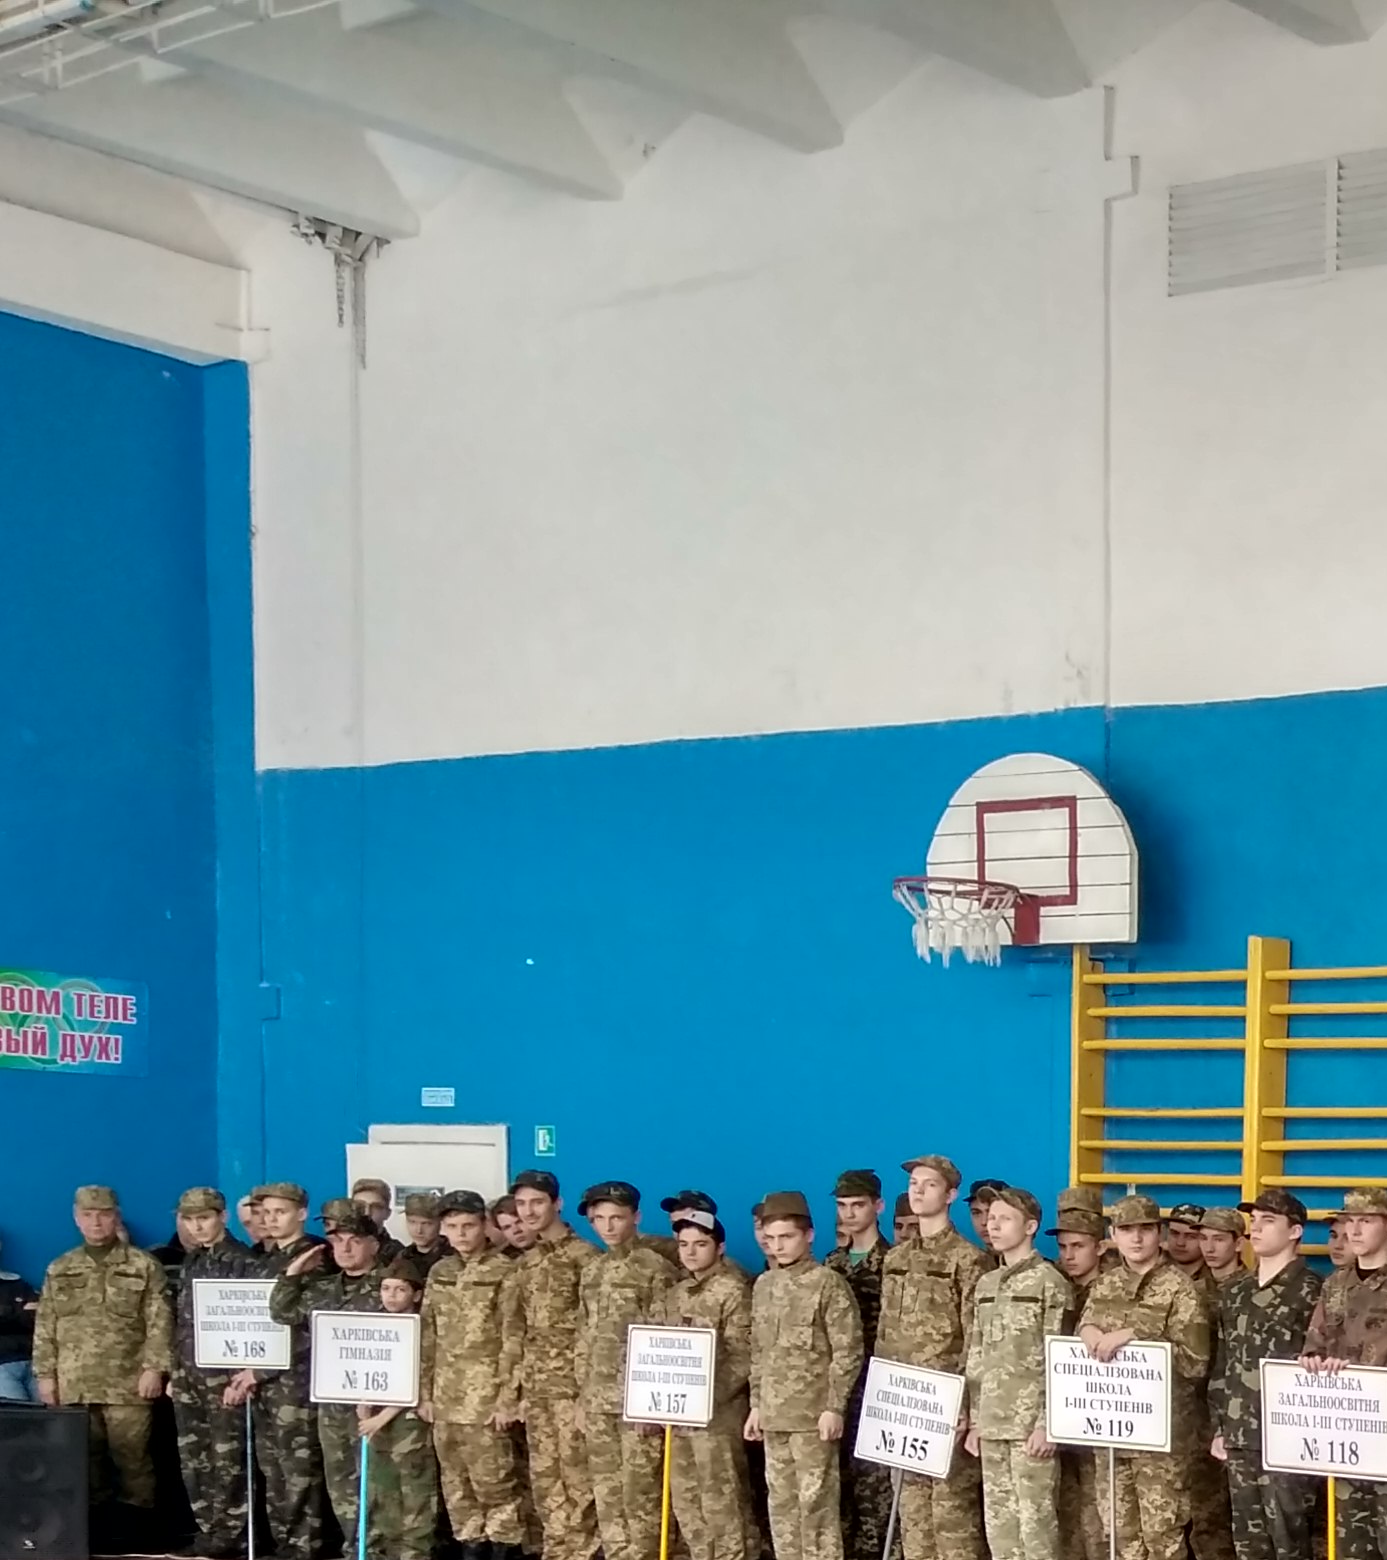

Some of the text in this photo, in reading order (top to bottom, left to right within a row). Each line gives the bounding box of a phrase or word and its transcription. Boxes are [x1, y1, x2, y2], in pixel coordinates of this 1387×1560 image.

[72, 990, 137, 1024] ТЕЛЕ
[0, 1024, 122, 1064] ЫЙ ДУХ!
[332, 1327, 400, 1342] ХАРКІВСЬКА
[223, 1340, 267, 1358] № 168
[339, 1346, 392, 1361] ГІМНАЗІЯ
[342, 1370, 388, 1391] № 163
[1054, 1362, 1163, 1381] СПЕЦІАЛІЗОВАНА
[1294, 1373, 1363, 1391] ХАРКІВСЬКА
[888, 1374, 937, 1396] ХАРКІВСЬКА
[1086, 1381, 1132, 1396] ШКОЛА
[648, 1391, 687, 1414] № 157
[876, 1390, 943, 1416] СПЕЦІАЛІЗОВАНА
[1089, 1398, 1153, 1414] СТУПЕНІВ
[1278, 1392, 1380, 1413] ЗАГАЛЬНООСВІТНЯ
[865, 1405, 892, 1423] ШКОЛА
[909, 1416, 951, 1436] СТУПЕНІВ
[1083, 1417, 1134, 1438] № 119
[1271, 1411, 1309, 1428] ШКОЛА
[875, 1429, 929, 1461] № 155
[1300, 1437, 1359, 1466] № 118
